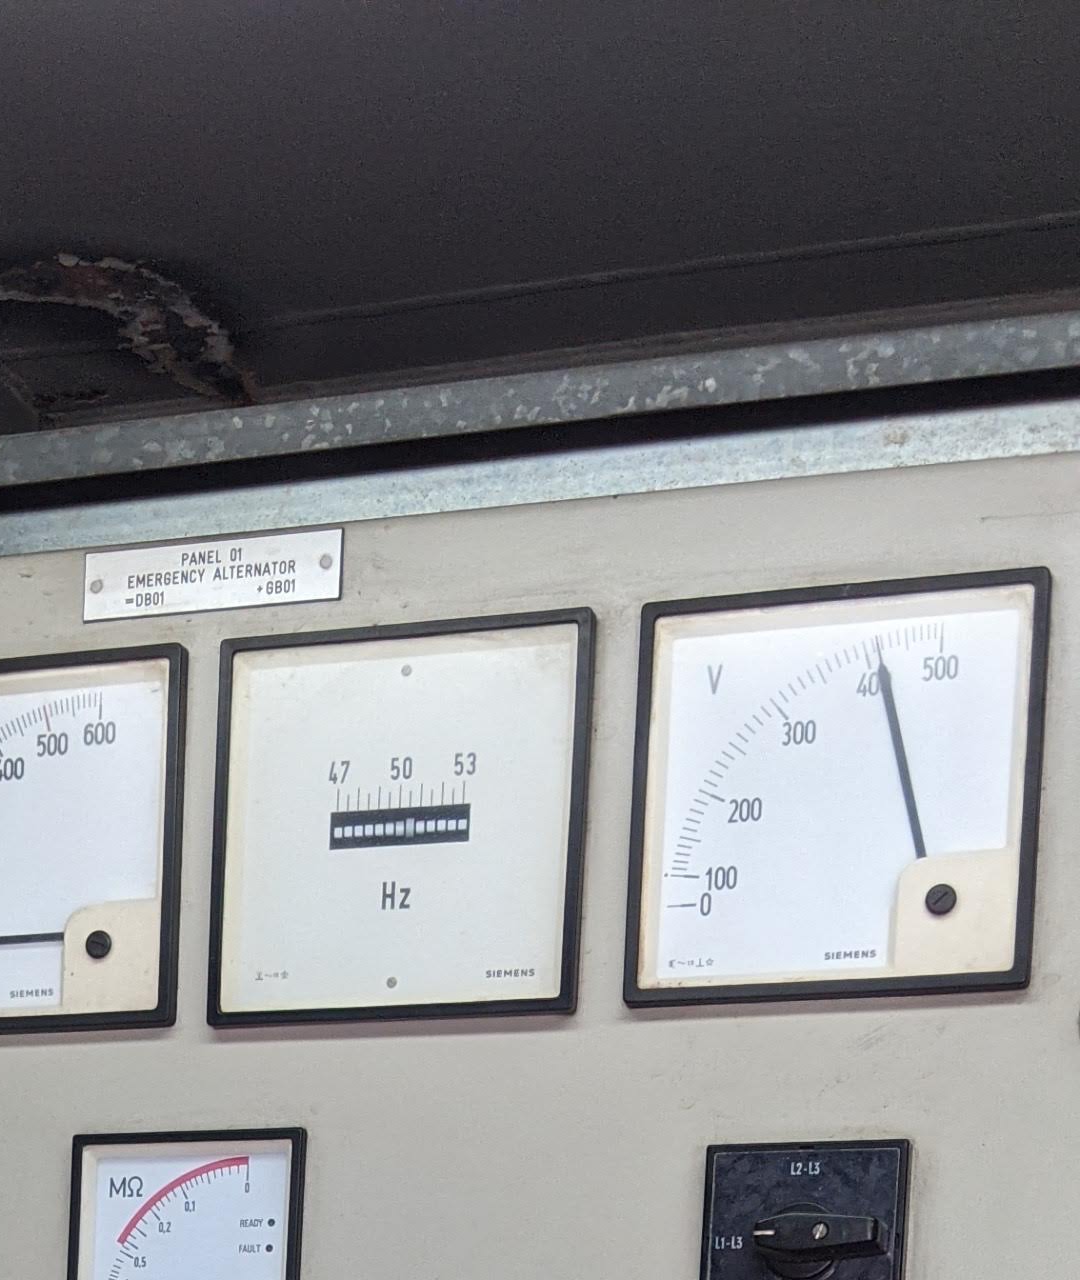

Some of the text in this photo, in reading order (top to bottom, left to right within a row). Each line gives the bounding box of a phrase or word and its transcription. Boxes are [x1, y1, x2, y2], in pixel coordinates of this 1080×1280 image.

[181, 548, 242, 566] PANEL 01
[127, 560, 296, 590] EMERGENCY ALTERNATOR
[707, 664, 723, 695] V
[922, 655, 959, 682] 500
[856, 672, 886, 697] 40
[36, 733, 69, 757] 500
[83, 721, 116, 745] 600
[782, 720, 816, 747] 300
[328, 752, 477, 785] 47 50 53
[727, 797, 763, 824] 200
[705, 866, 738, 891] 100
[381, 881, 411, 911] Hz
[699, 892, 712, 917] 0
[824, 949, 878, 961] SIEMENS
[485, 968, 536, 979] SIEMENS
[9, 988, 54, 998] SIEMENS
[790, 1162, 820, 1175] L2-L3
[244, 1182, 250, 1194] 0
[240, 1219, 263, 1227] READY
[239, 1244, 261, 1253] FAULT
[715, 1236, 743, 1249] L1-L3
